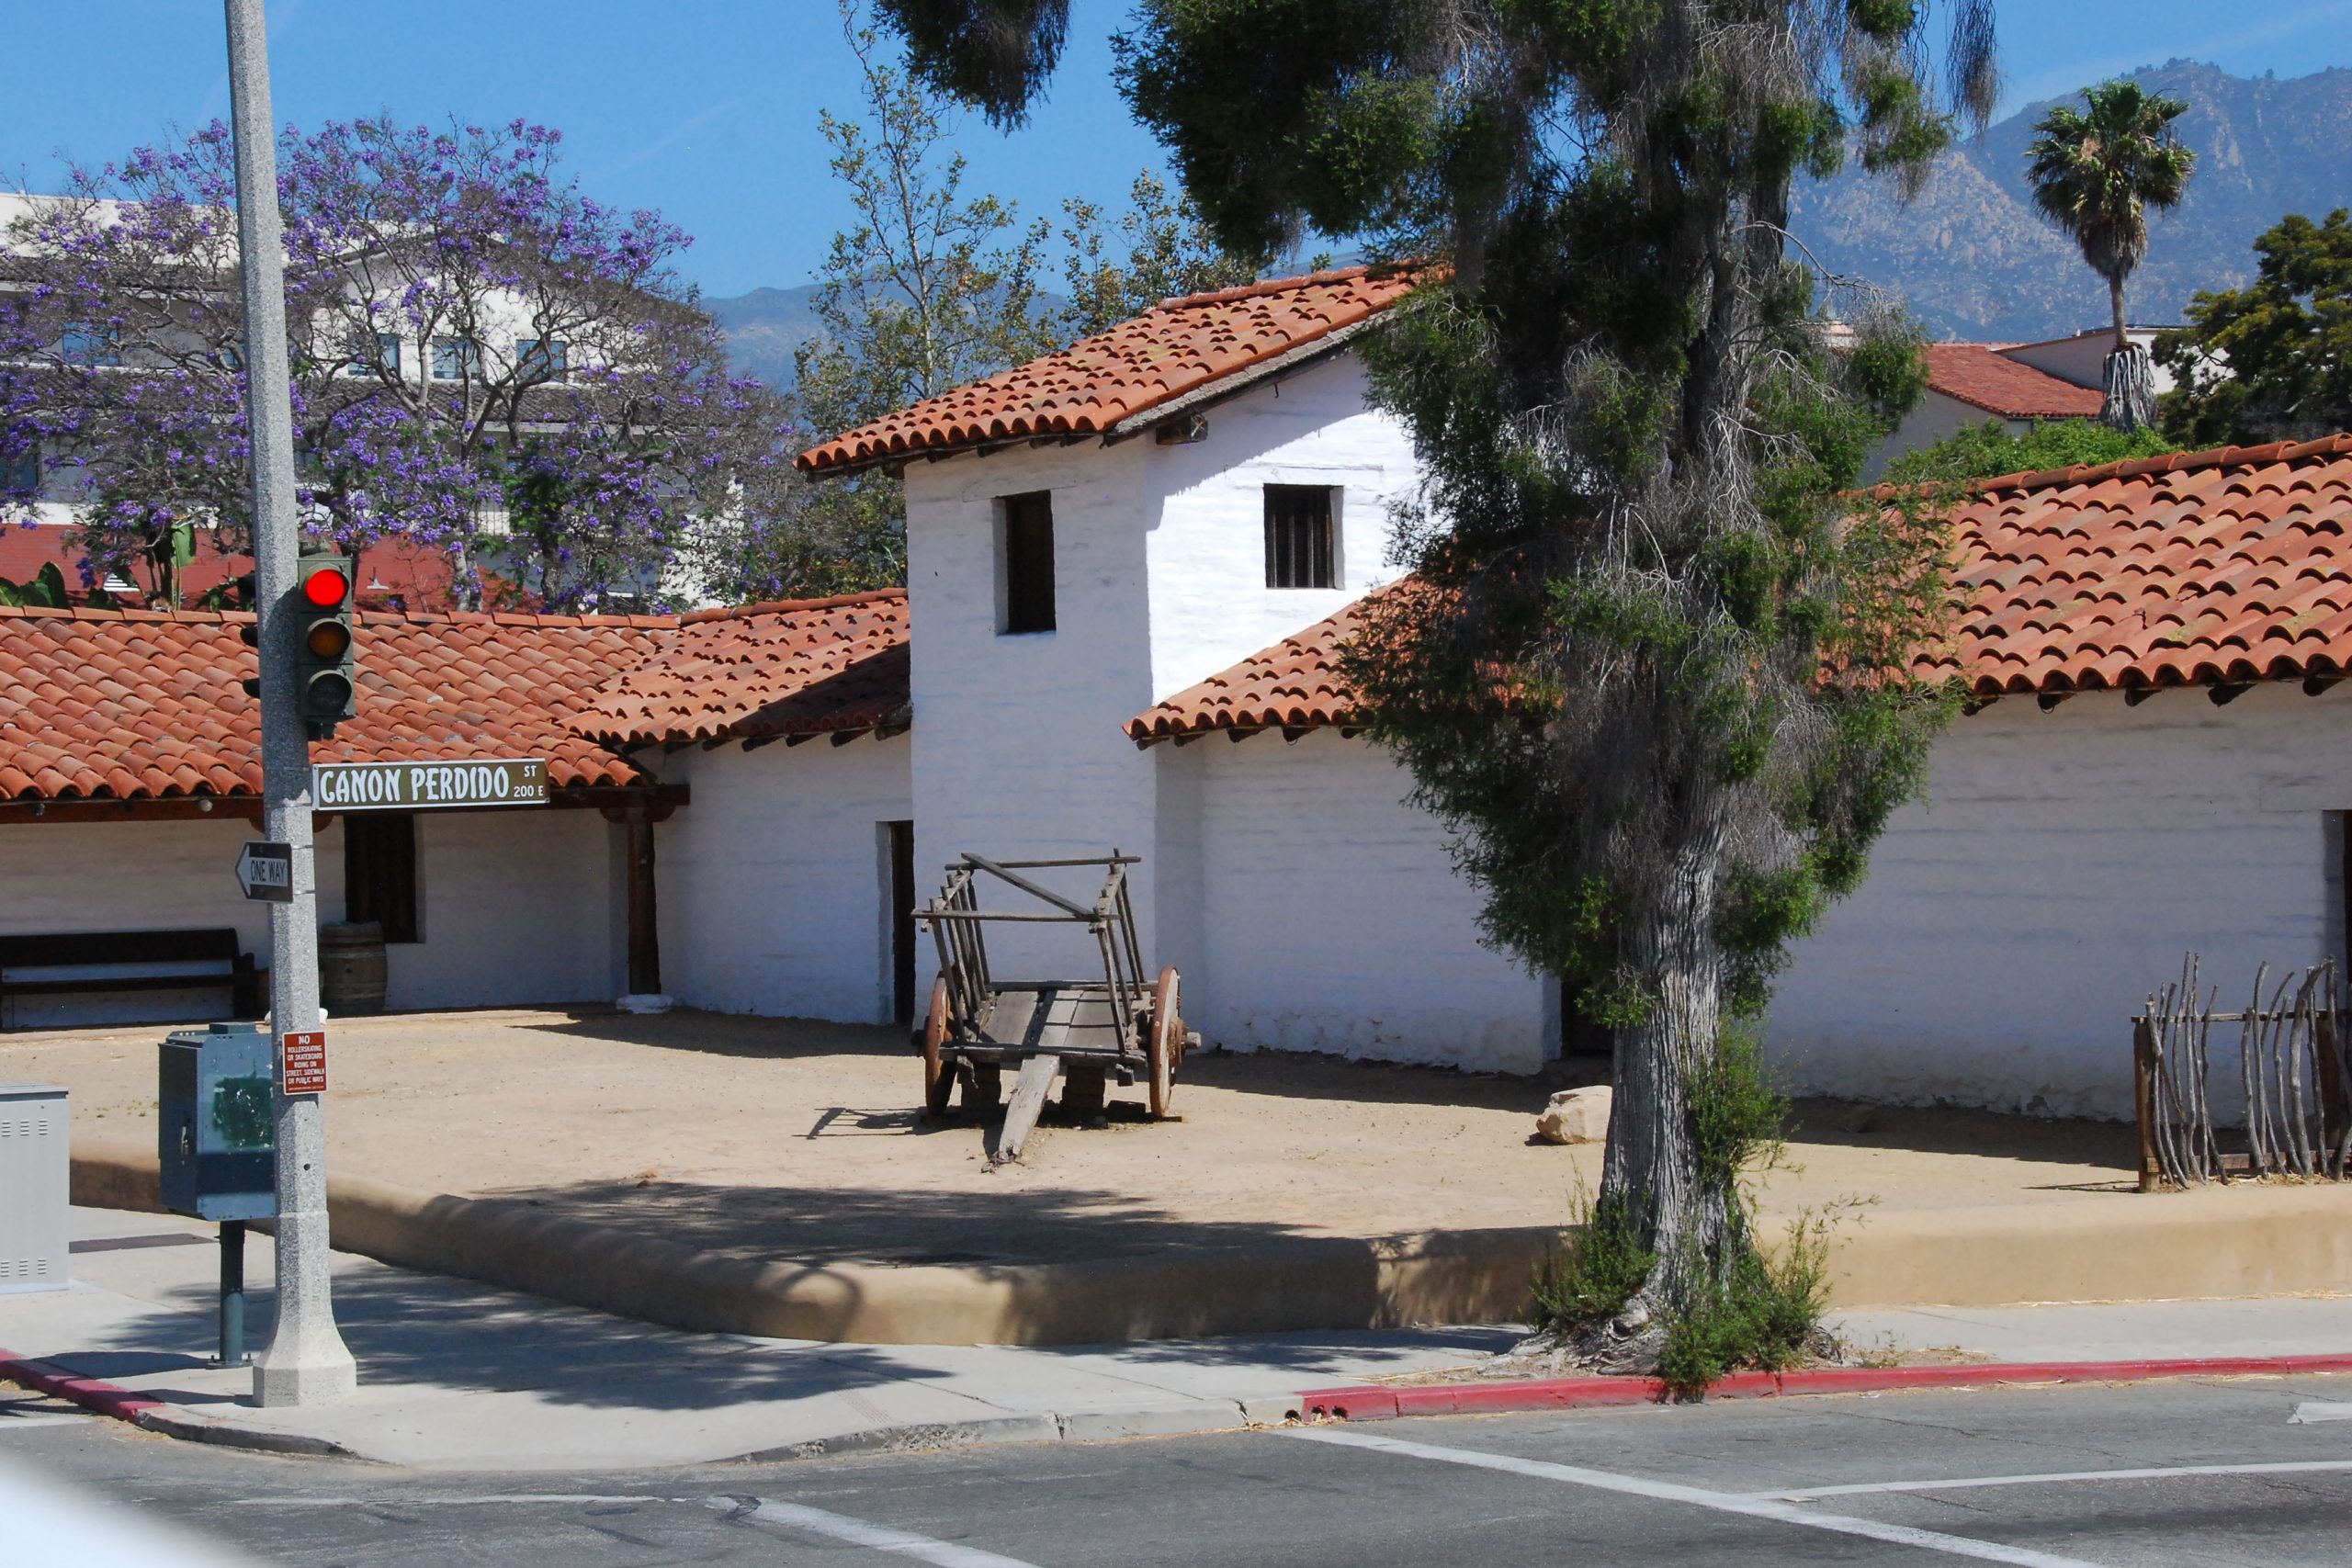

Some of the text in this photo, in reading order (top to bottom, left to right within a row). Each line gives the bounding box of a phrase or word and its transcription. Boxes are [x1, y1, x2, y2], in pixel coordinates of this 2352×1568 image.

[524, 765, 537, 777] ST
[321, 766, 510, 804] CANON PERDIDO
[514, 784, 544, 798] 200 E
[250, 860, 286, 883] ONE WAY
[299, 1035, 311, 1044] NO
